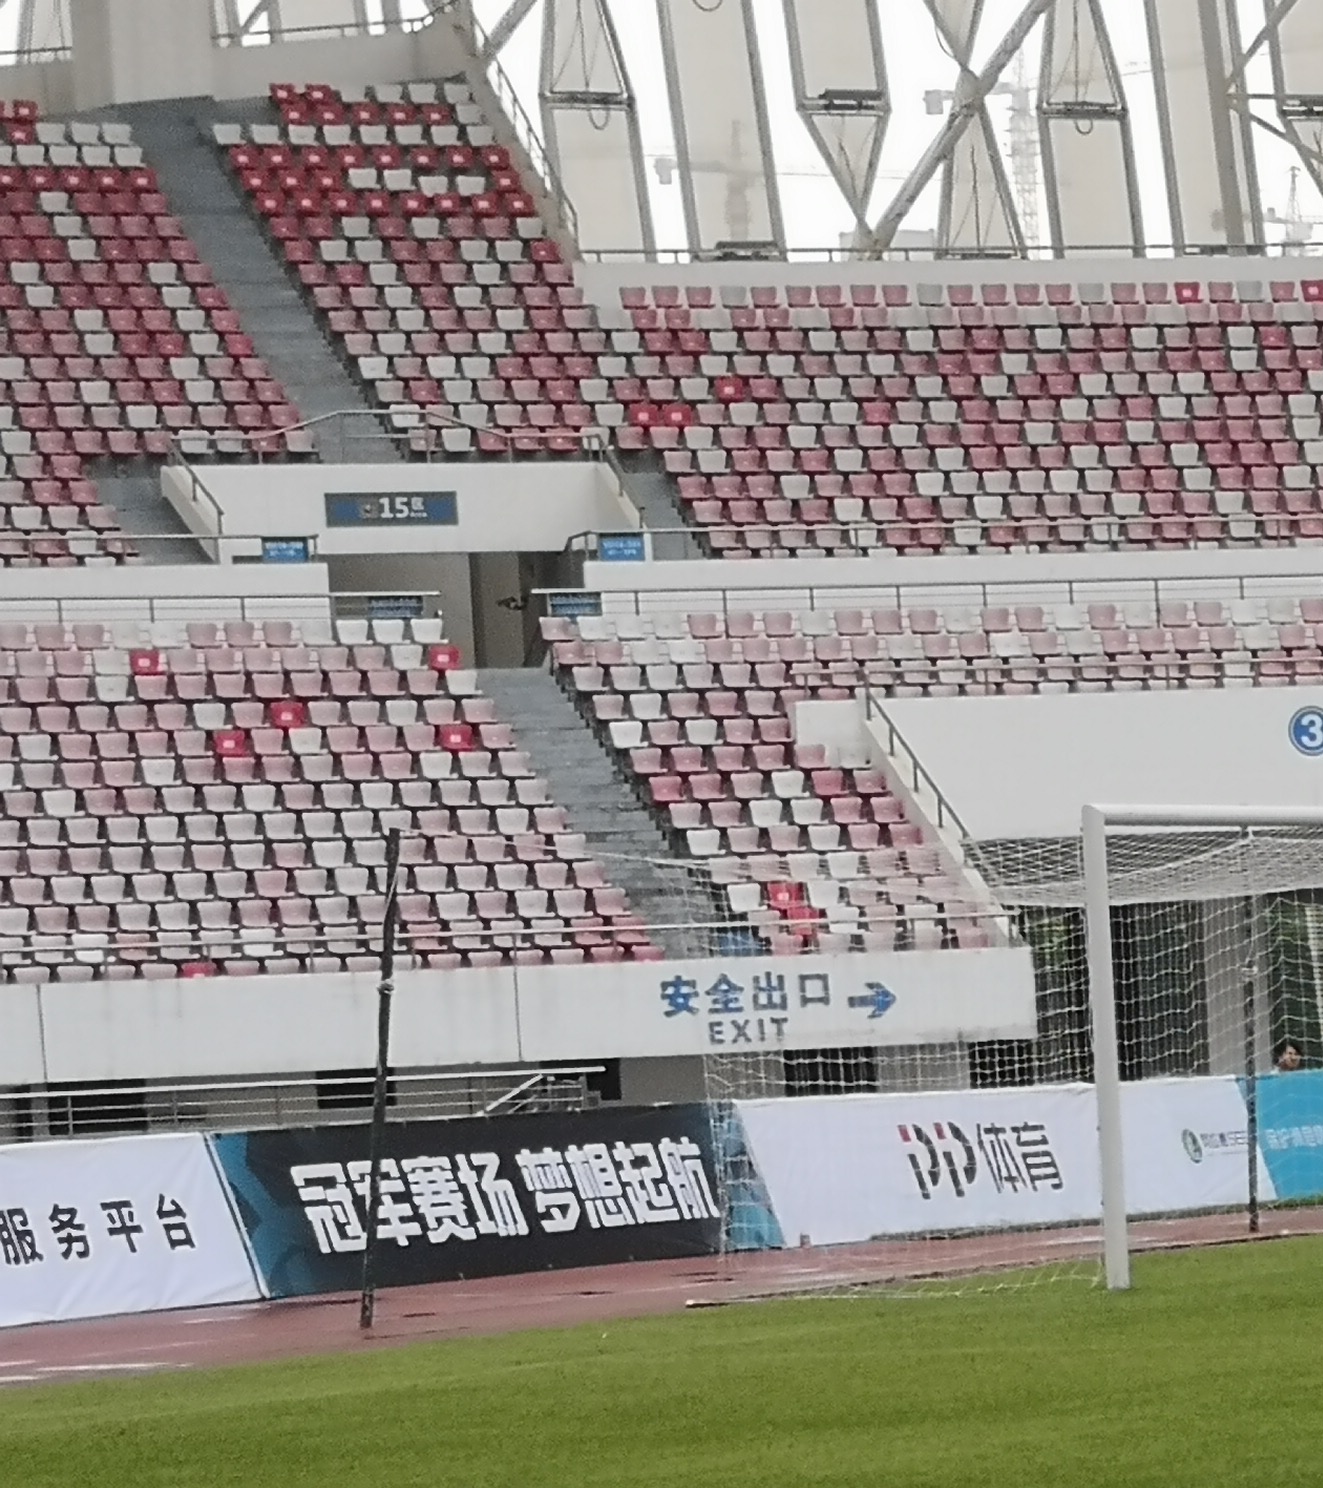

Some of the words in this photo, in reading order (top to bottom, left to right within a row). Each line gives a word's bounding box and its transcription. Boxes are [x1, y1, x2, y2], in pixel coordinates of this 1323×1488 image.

[660, 971, 831, 1018] 安全出口
[708, 1016, 789, 1045] EXIT
[290, 1153, 530, 1255] 冠军赛场
[514, 1136, 721, 1231] 梦想起航
[0, 1193, 196, 1266] 服务平台
